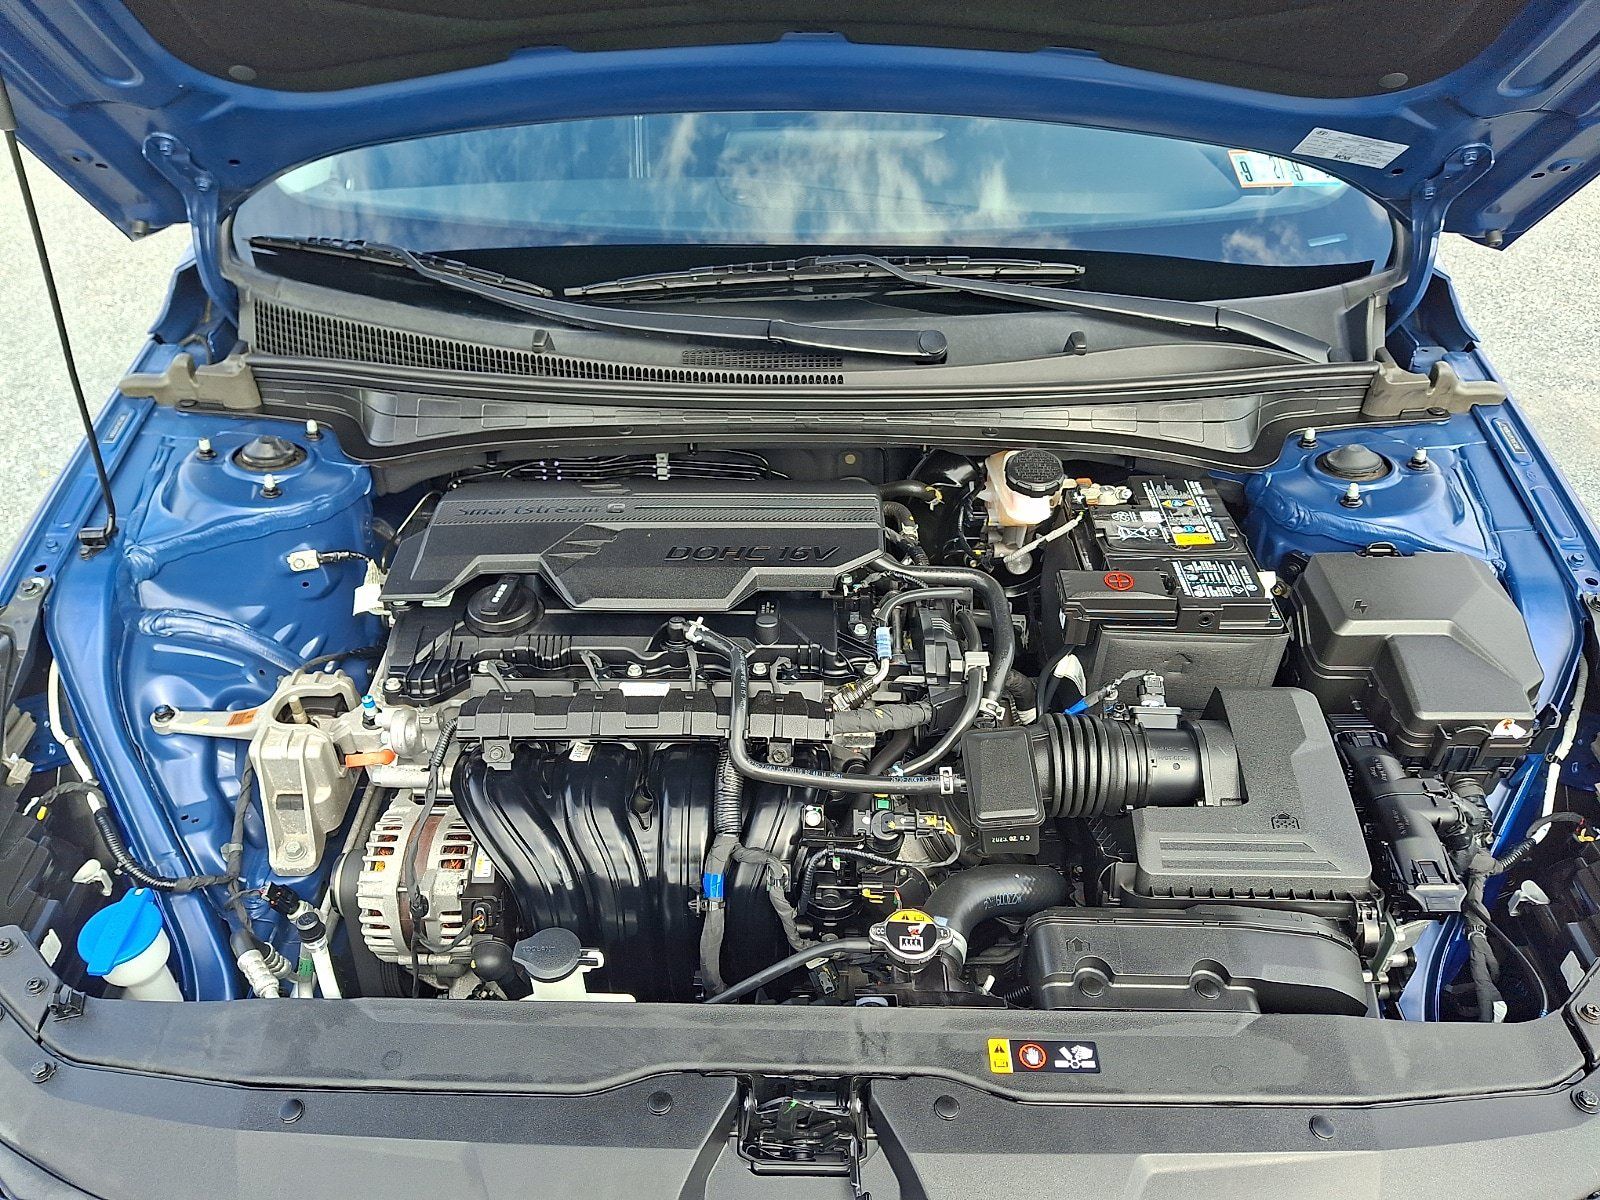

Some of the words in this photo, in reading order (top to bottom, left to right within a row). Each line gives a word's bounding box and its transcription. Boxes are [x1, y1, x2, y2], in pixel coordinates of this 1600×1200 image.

[1240, 160, 1253, 181] 9
[458, 504, 600, 517] Smartstream
[663, 545, 771, 562] DOHC
[778, 545, 841, 562] 16V
